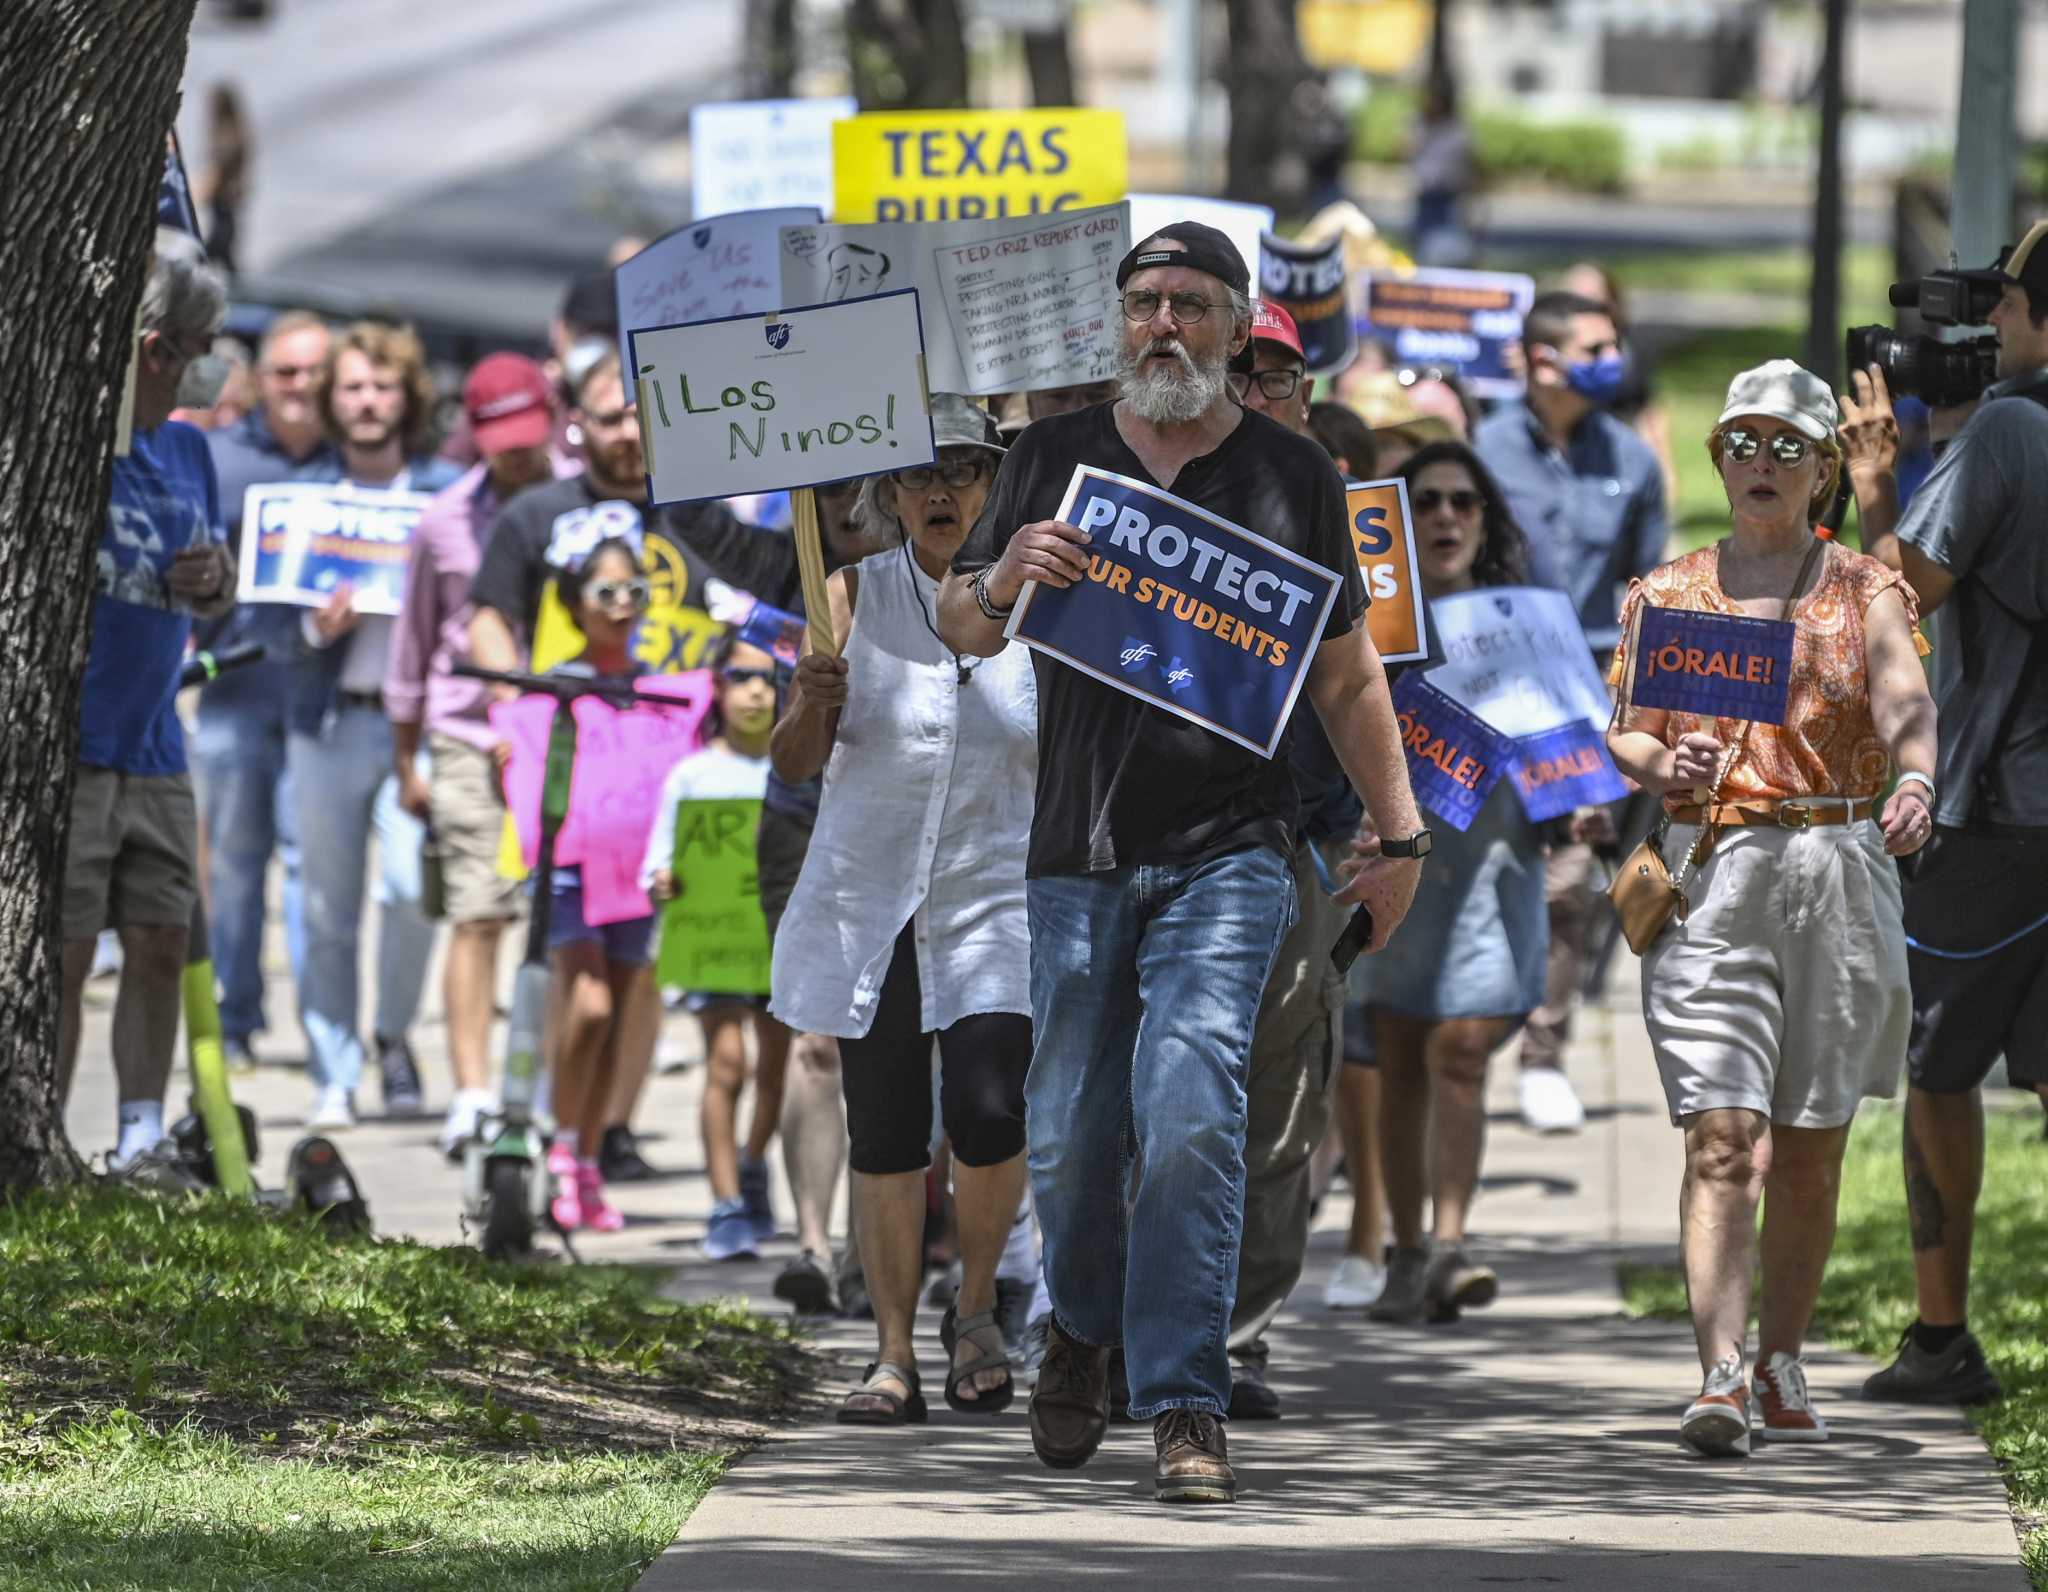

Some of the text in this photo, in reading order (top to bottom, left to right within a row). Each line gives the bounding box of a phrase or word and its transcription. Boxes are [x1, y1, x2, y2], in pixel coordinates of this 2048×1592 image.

[882, 127, 1070, 178] TEXAS
[952, 246, 991, 265] TED
[994, 237, 1032, 258] CRUZ
[1033, 225, 1082, 248] REPORT
[1084, 216, 1120, 238] CARD
[958, 278, 1026, 303] PROTECTING
[962, 299, 1003, 322] TAKING
[966, 311, 1033, 338] PROTECTING
[1033, 296, 1078, 320] CHILDREN
[971, 331, 1014, 352] HUMAN
[1015, 315, 1068, 340] DECENCY
[976, 350, 1015, 376] EXTRA
[1078, 495, 1314, 627] PROTECT
[1086, 554, 1134, 595] UR
[1135, 576, 1293, 668] STUDENTS
[1119, 643, 1158, 667] aft
[1648, 636, 1774, 685] ¡ÓRALE!
[1167, 667, 1194, 684] aft
[1397, 708, 1488, 791] ÓRALE!
[690, 946, 765, 982] peop
